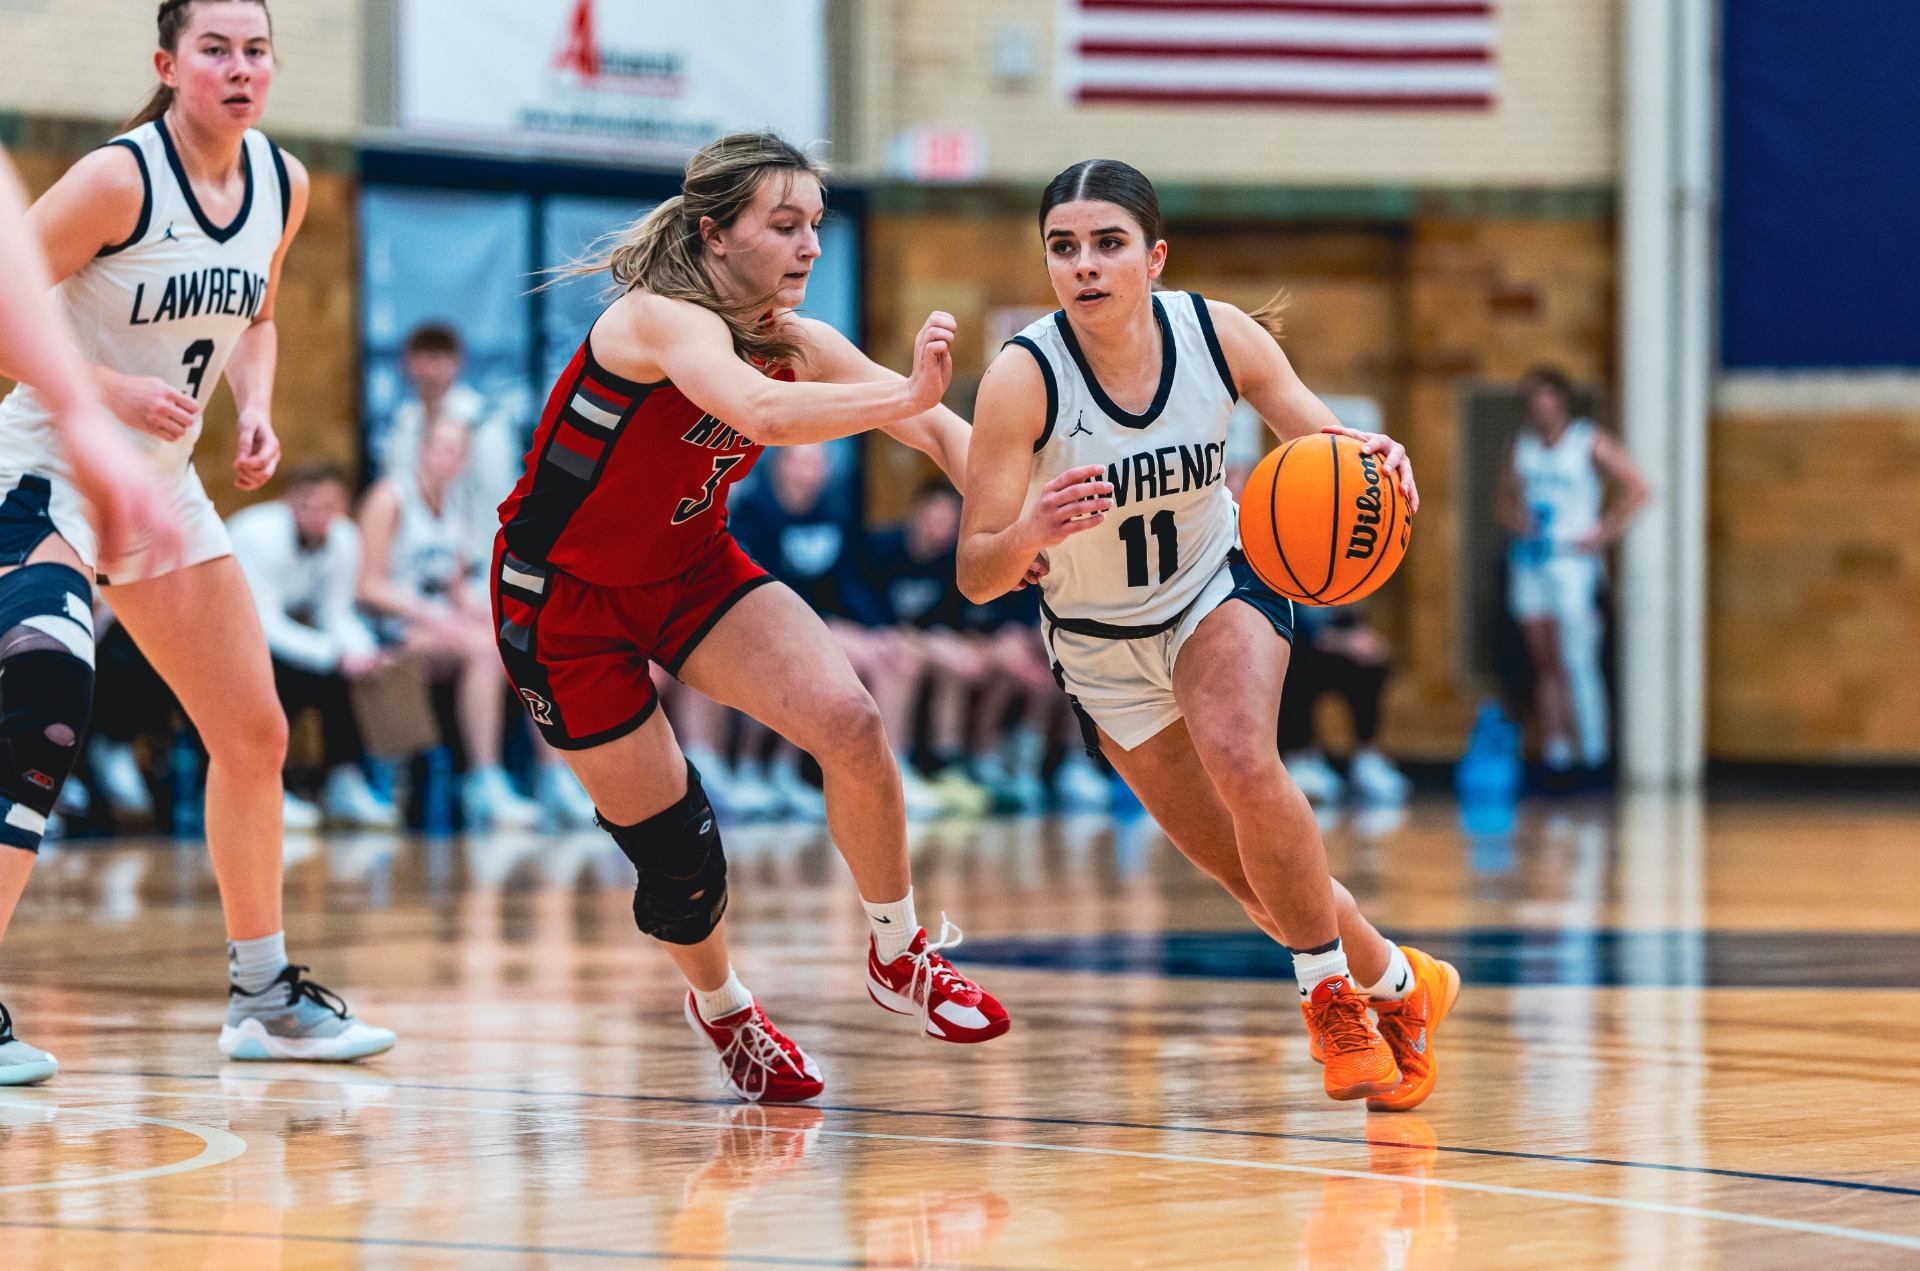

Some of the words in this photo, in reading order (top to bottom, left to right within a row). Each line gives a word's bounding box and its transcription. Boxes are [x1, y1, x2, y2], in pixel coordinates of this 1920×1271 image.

[181, 338, 215, 400] 3
[670, 453, 746, 526] 3
[1345, 451, 1382, 560] Wilson
[1118, 509, 1179, 588] 11
